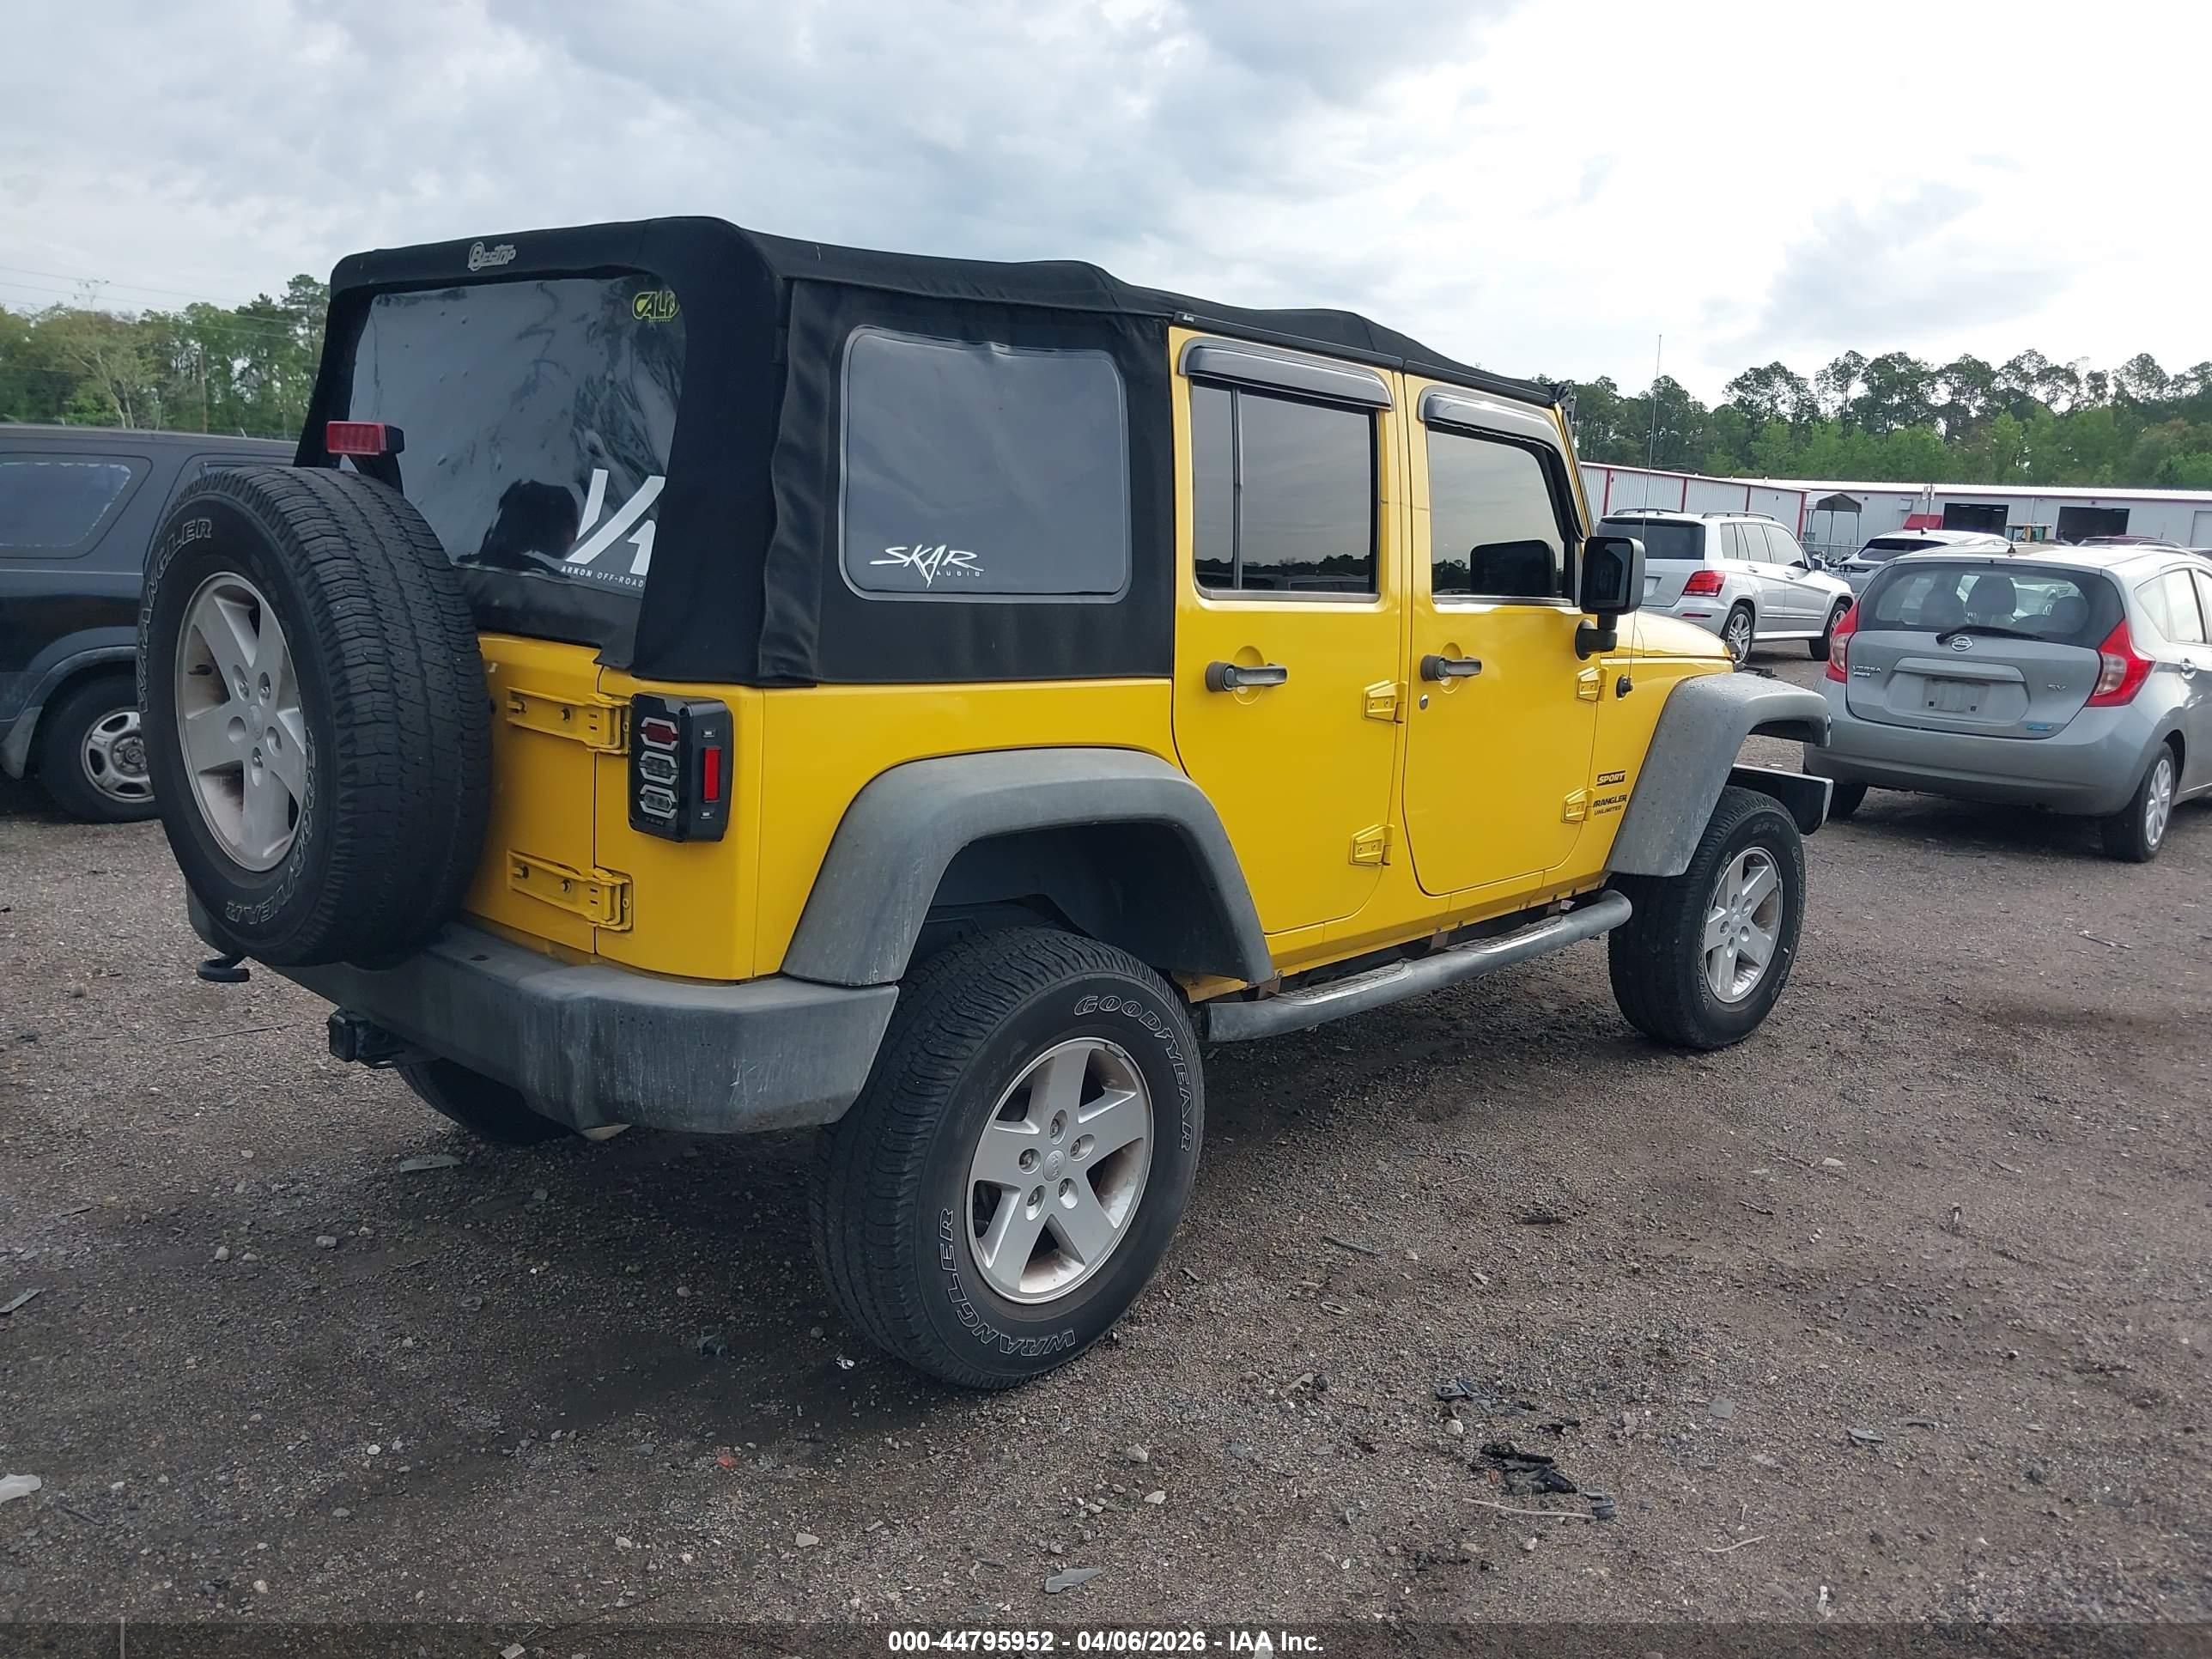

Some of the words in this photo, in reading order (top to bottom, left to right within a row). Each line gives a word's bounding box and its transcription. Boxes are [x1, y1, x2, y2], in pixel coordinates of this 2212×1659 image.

[561, 565, 592, 577] ARKON
[597, 572, 644, 588] OFF-ROAD
[869, 544, 984, 588] SKAR
[136, 519, 212, 714] WRANGLER
[1598, 773, 1625, 782] SPORT
[1594, 805, 1622, 816] UNLIMITED
[1073, 995, 1193, 1152] GOODYEAR
[939, 1208, 1076, 1357] WRANGLER
